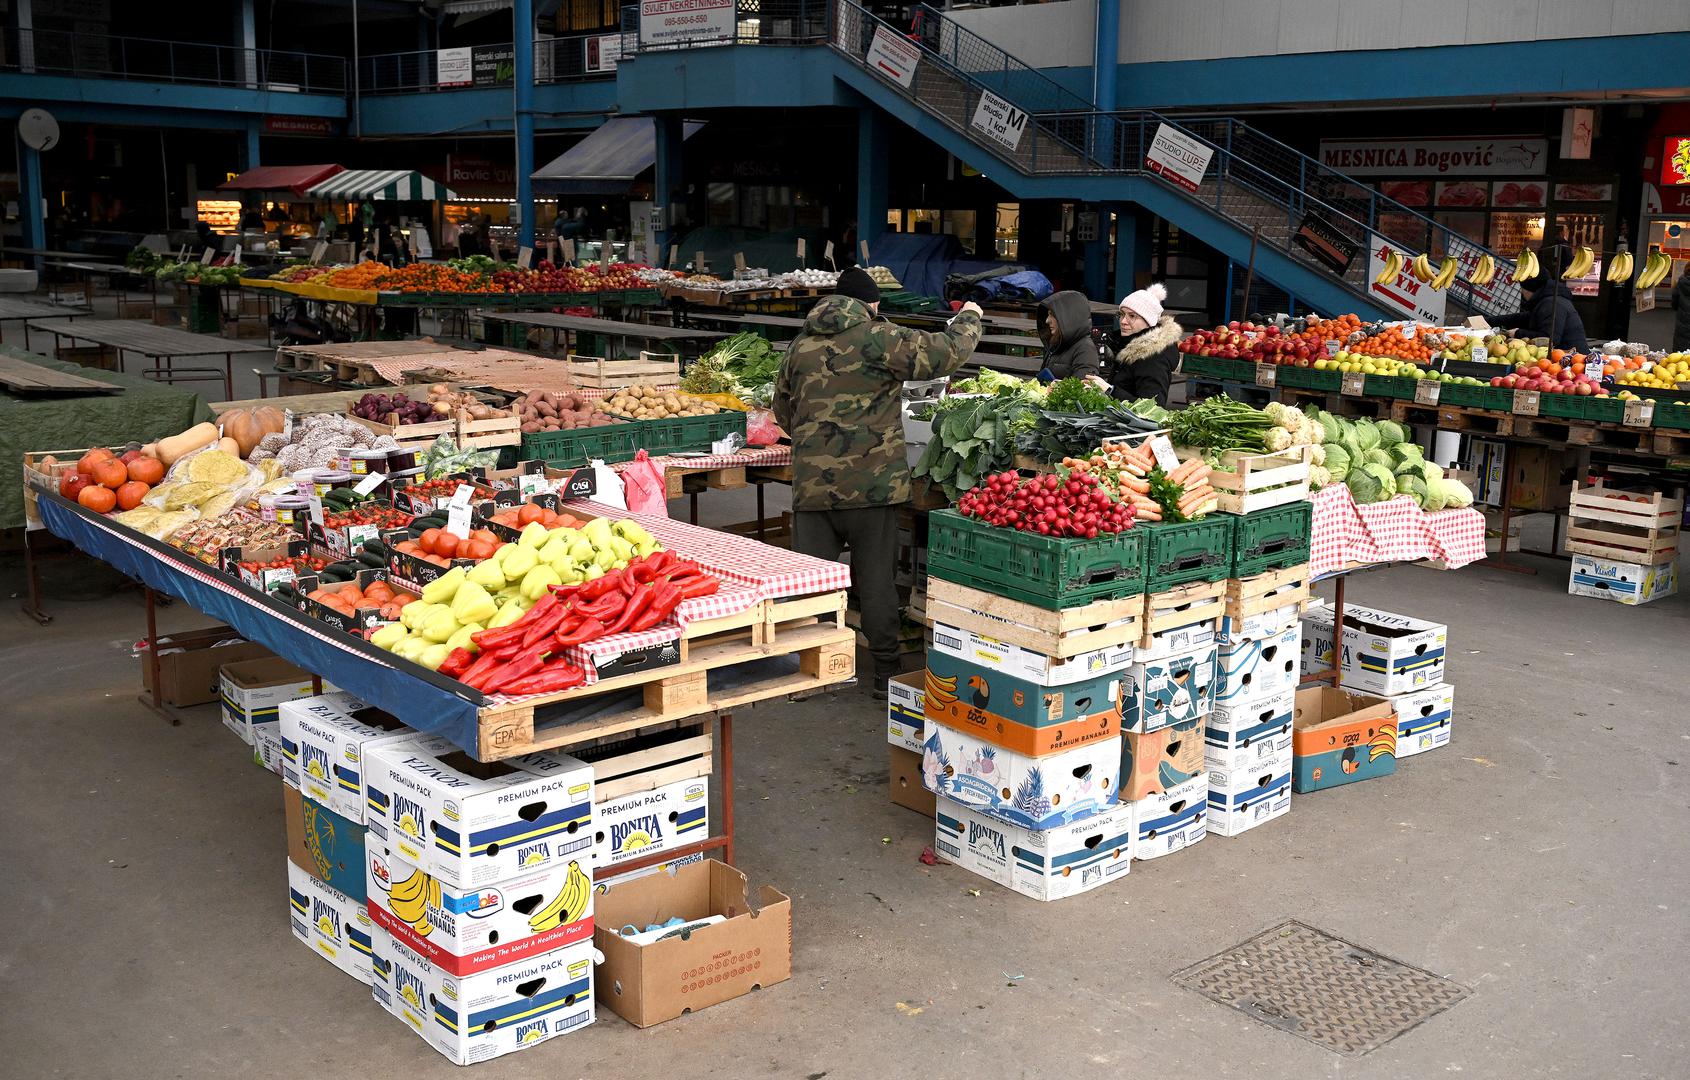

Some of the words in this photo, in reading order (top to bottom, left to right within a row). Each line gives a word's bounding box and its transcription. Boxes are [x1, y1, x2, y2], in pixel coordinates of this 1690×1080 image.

[644, 3, 669, 14] SVIJET
[982, 104, 1003, 120] studio
[984, 92, 1009, 112] frizerski
[1006, 107, 1026, 131] M
[993, 121, 1007, 135] kat
[1155, 138, 1182, 157] STUDIO
[1181, 151, 1205, 171] LUPE
[1324, 149, 1408, 168] MESNICA
[1413, 144, 1494, 172] Bogović
[1423, 311, 1439, 324] KAT
[571, 480, 589, 491] CASI
[1348, 607, 1411, 628] BONITA
[1311, 624, 1335, 635] PREMI
[1342, 631, 1359, 641] PACK
[1315, 637, 1352, 665] BONTA
[309, 705, 377, 737] BANANAS
[967, 709, 987, 726] toco
[299, 721, 321, 738] PREMIUM
[321, 732, 336, 744] PACK
[1050, 737, 1080, 750] PREMIUM
[1080, 728, 1110, 741] BANANAS
[301, 740, 331, 780] BONITA
[401, 757, 471, 788] BONITA
[389, 770, 416, 791] PREMIUM
[416, 783, 432, 799] PACK
[498, 787, 539, 804] PREMIUM
[541, 780, 564, 793] PACK
[601, 800, 642, 816] PREMIUM
[644, 793, 667, 805] PACK
[1158, 791, 1182, 803] PREMIUM
[393, 791, 427, 838] BONITA
[1071, 822, 1098, 835] PREMIUM
[1099, 816, 1113, 827] PACK
[610, 813, 663, 852] BONITA
[968, 819, 1007, 858] BONITA
[517, 842, 551, 865] BONITA
[611, 852, 637, 861] PREMIUM
[373, 860, 390, 878] Dole
[309, 876, 333, 896] PREMIUM
[333, 890, 348, 905] PACK
[479, 893, 499, 908] ole
[312, 895, 342, 939] BONITA
[440, 910, 456, 925] Extra
[473, 953, 496, 964] Making
[497, 948, 510, 956] The
[511, 943, 529, 952] World
[537, 931, 564, 944] Healthier
[566, 926, 582, 935] Place
[712, 950, 732, 960] PACKER
[391, 940, 416, 965] PREMIUM
[416, 960, 432, 975] PACK
[496, 967, 539, 985] PREMIUM
[540, 959, 563, 972] PACK
[394, 961, 427, 1011] BONITA
[515, 1018, 549, 1043] BONITA
